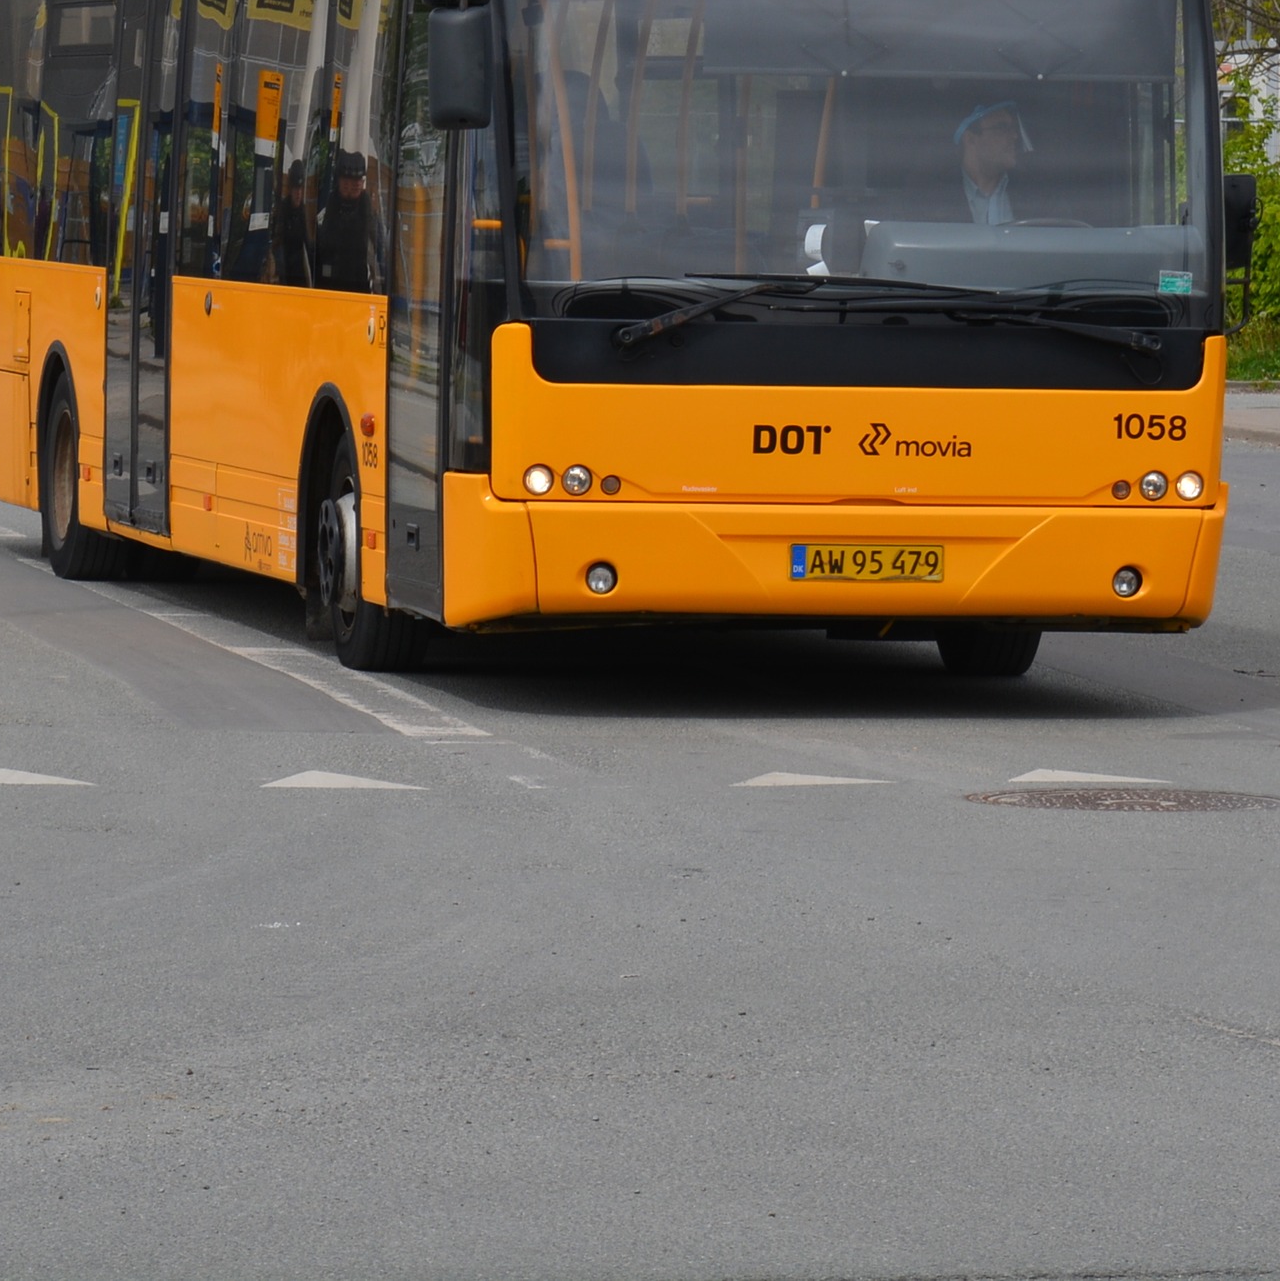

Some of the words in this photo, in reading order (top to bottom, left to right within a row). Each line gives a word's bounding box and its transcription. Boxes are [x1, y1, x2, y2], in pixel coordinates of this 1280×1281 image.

[752, 424, 832, 455] DOT
[895, 435, 972, 458] movia
[1113, 413, 1187, 441] 1058
[361, 441, 378, 469] 1058
[792, 565, 804, 573] DK
[809, 550, 845, 574] AW
[852, 550, 883, 575] 95
[892, 550, 939, 576] 479
